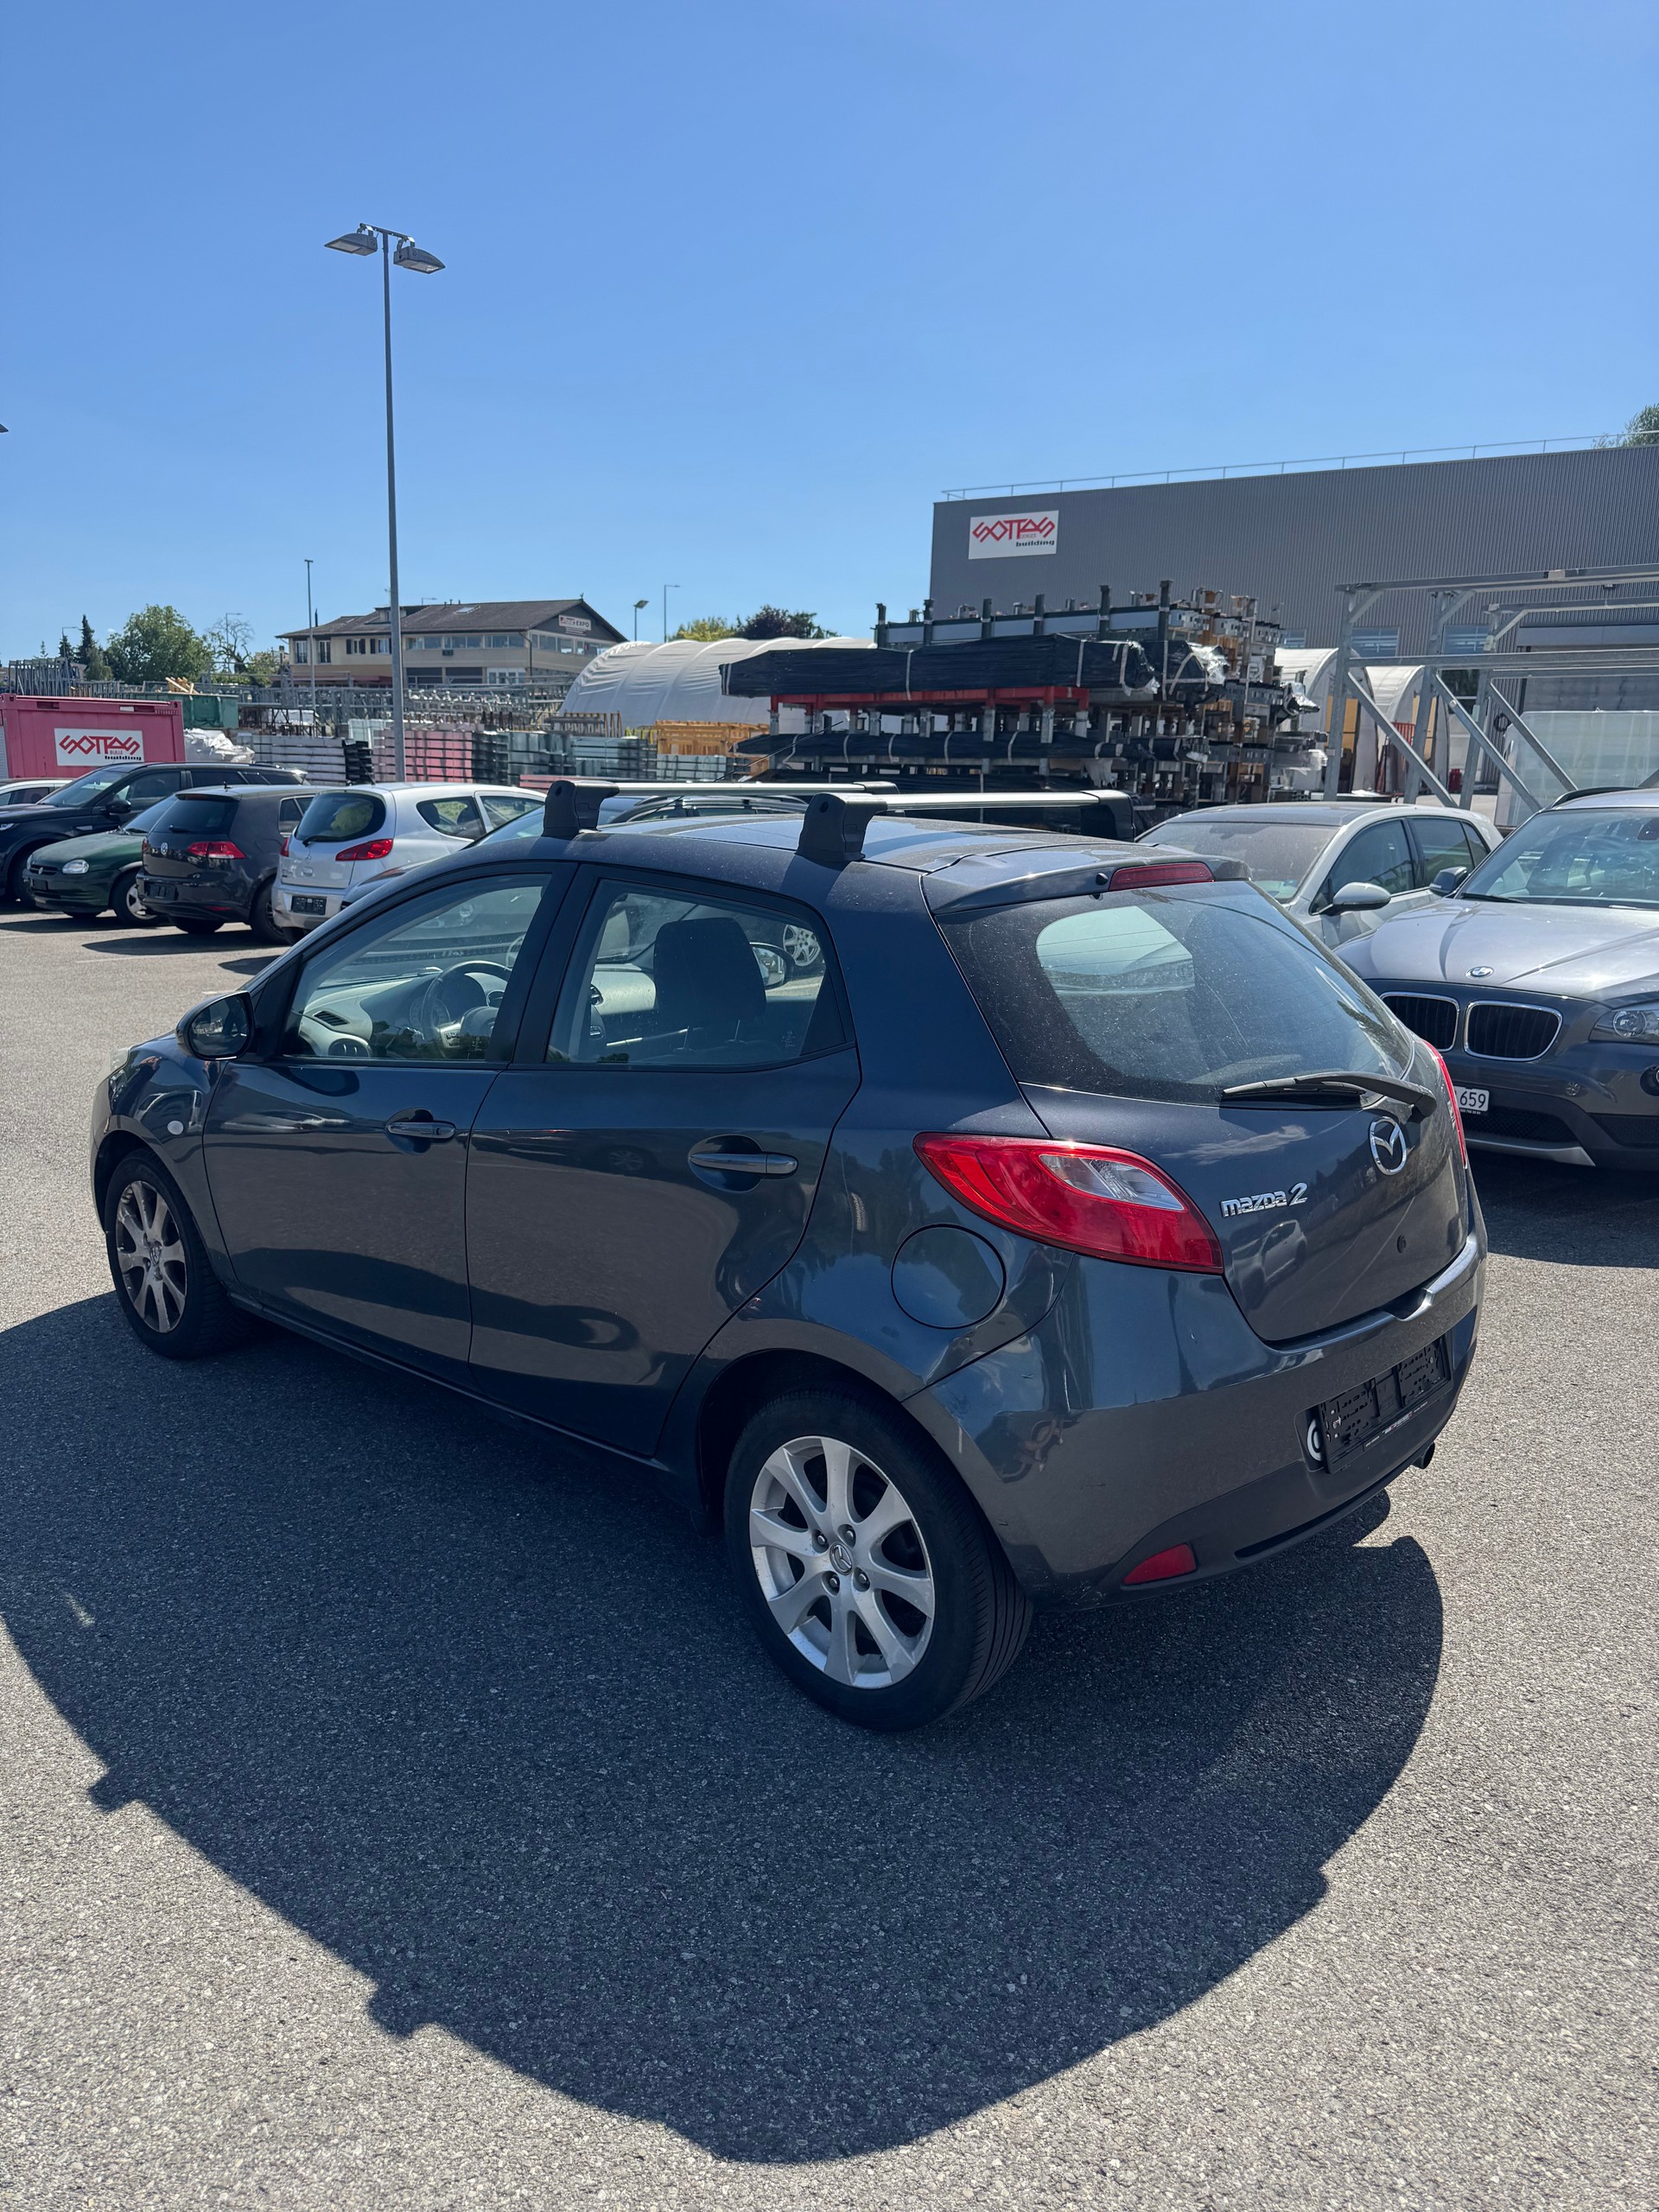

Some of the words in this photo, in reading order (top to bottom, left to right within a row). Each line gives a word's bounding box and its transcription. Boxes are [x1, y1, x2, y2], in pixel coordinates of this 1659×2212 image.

[972, 517, 1055, 543] SOTTAS
[59, 735, 140, 755] SOTTAS
[1460, 1090, 1486, 1109] 659
[1287, 1182, 1308, 1207] 2
